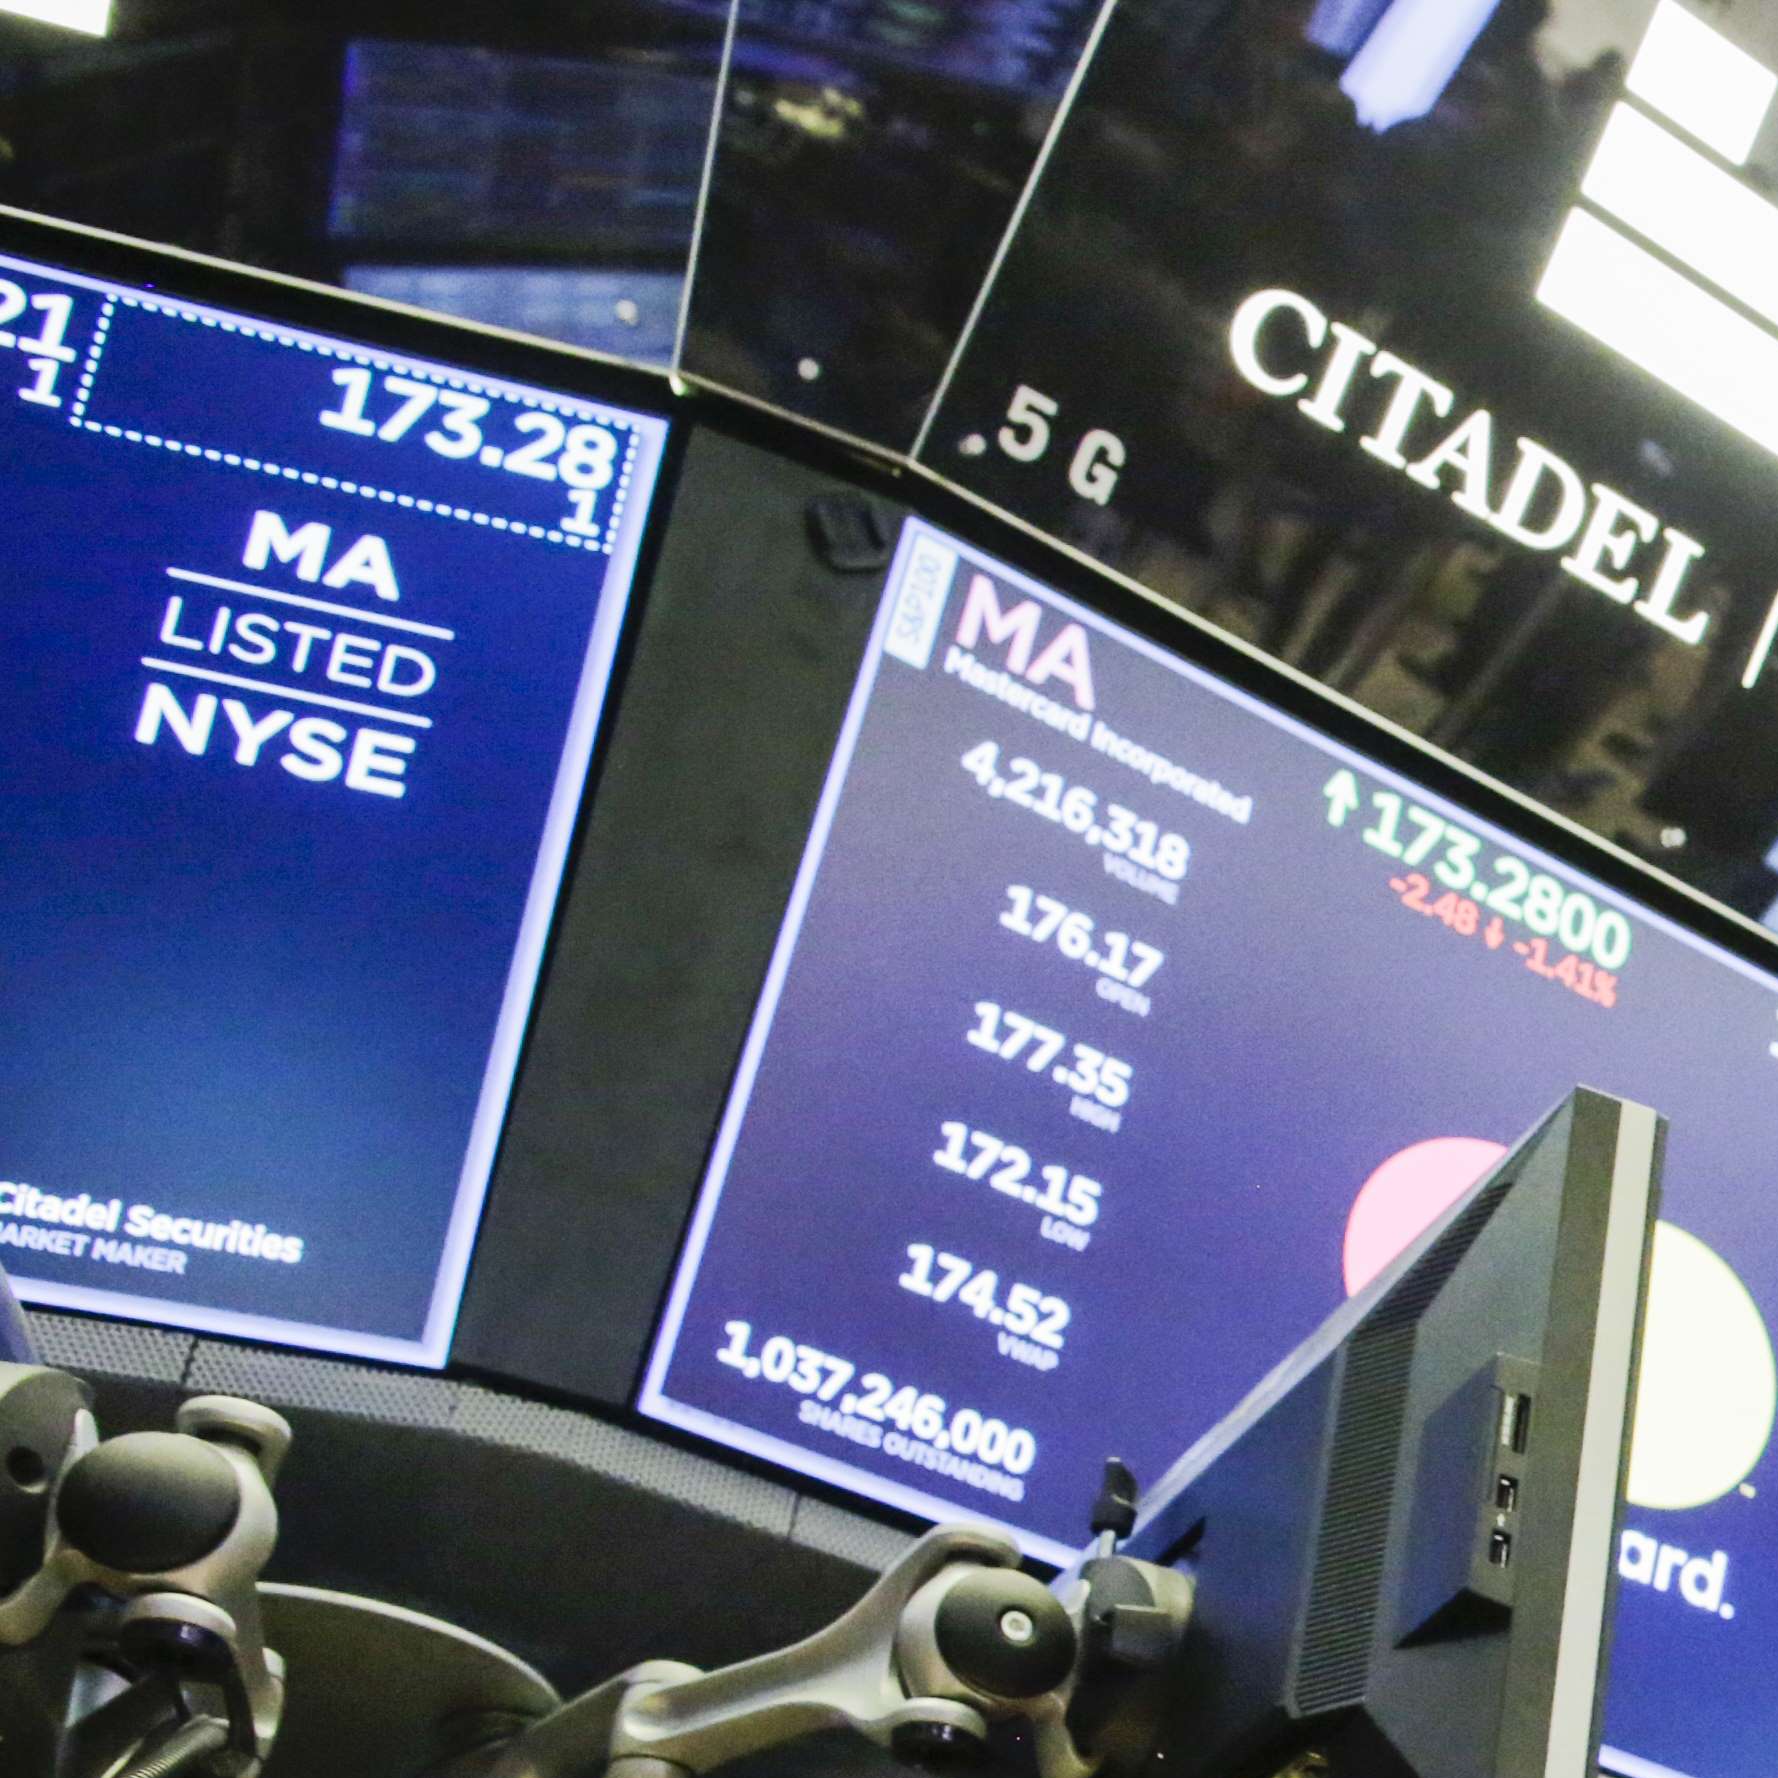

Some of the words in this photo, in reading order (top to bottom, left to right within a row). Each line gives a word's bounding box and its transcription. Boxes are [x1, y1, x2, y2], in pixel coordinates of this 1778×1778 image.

[18, 357, 62, 408] 1
[319, 366, 620, 489] 173.28
[559, 489, 599, 539] 1
[1227, 286, 1711, 646] CITADEL
[240, 509, 402, 602] MA
[159, 595, 437, 699] LISTED
[955, 572, 1097, 711] MA
[133, 682, 417, 799] NYSE
[943, 645, 1091, 742] Mastercard
[1091, 719, 1255, 825] Incorporated
[960, 740, 1191, 881] 4,216,318
[1361, 791, 1633, 971] 173.2800
[1389, 872, 1481, 937] -2.48
[999, 883, 1164, 988] 176.17
[965, 1001, 1134, 1108] 177.35
[932, 1120, 1102, 1225] 172.15
[91, 1238, 188, 1275] MAKER
[124, 1204, 304, 1264] Securities
[897, 1243, 1072, 1350] 174.52
[715, 1319, 1036, 1476] 1,037,246,000
[798, 1400, 883, 1450] SHARES
[882, 1432, 1025, 1503] OUTSTANDING
